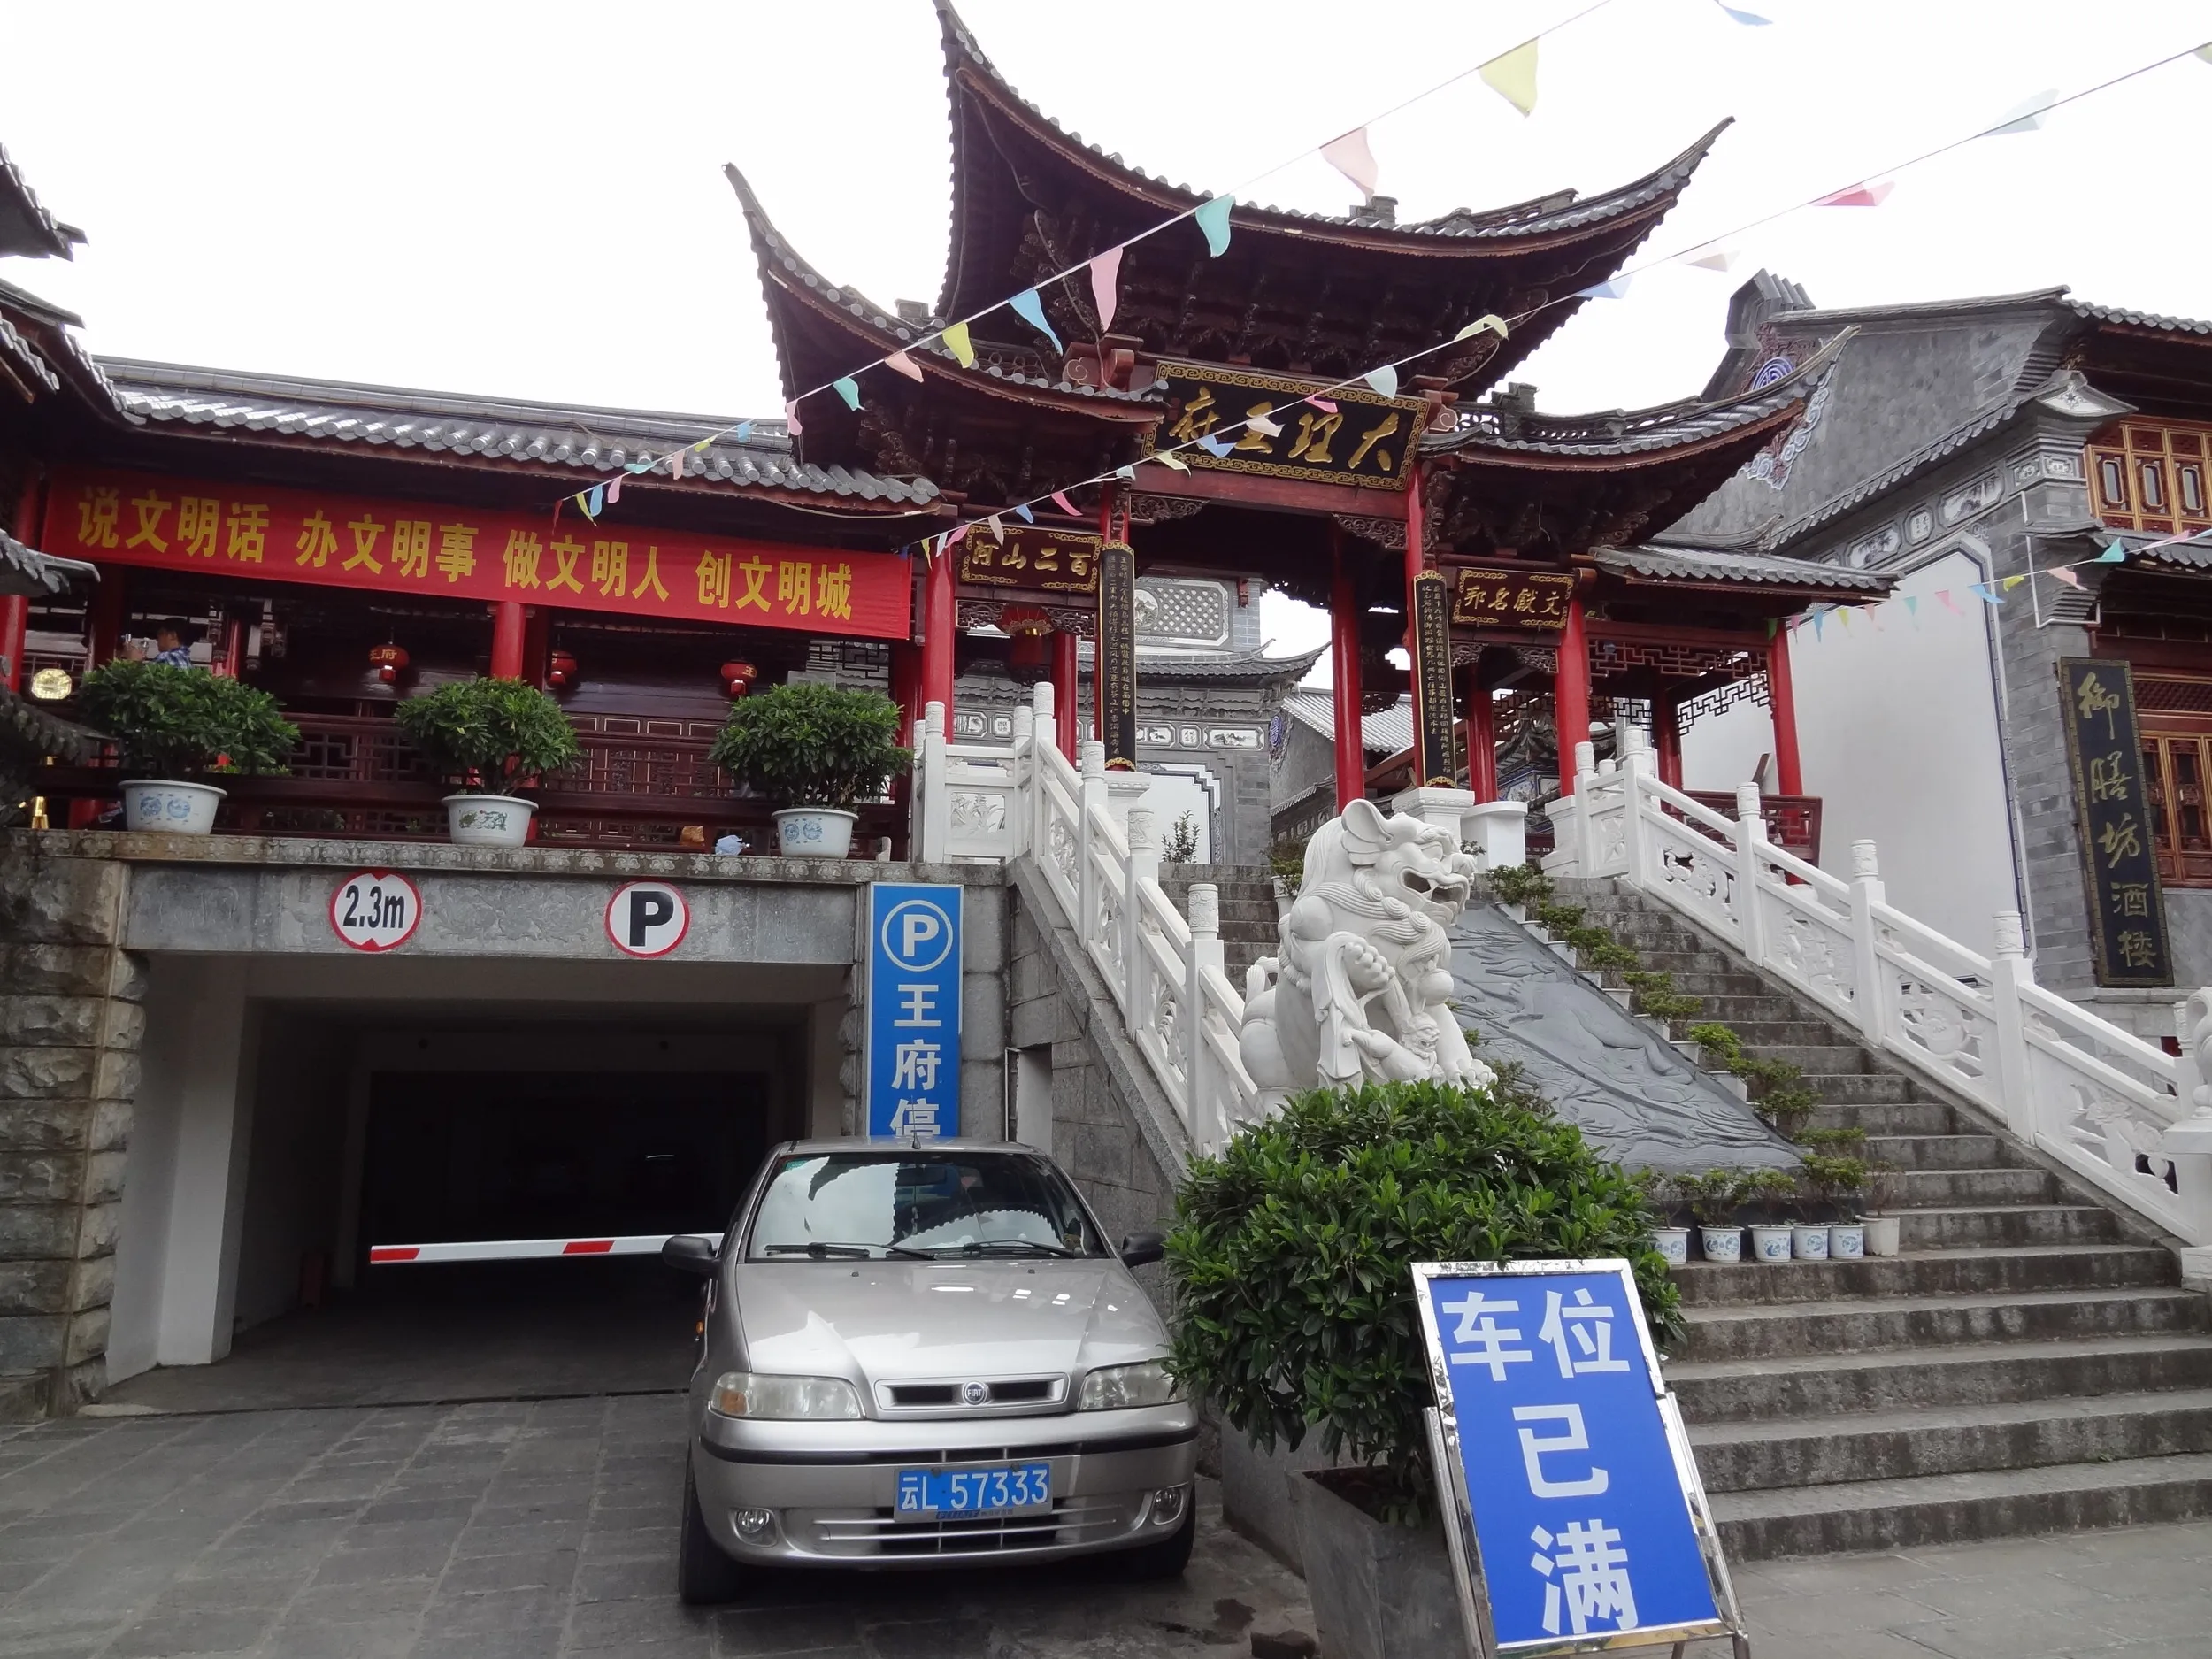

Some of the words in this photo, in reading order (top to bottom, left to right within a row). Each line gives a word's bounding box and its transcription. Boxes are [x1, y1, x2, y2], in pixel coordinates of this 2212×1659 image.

[78, 487, 270, 564] 说文明话
[296, 510, 479, 582] 办文明事
[503, 530, 669, 602] 做文明人
[695, 549, 852, 620] 创文明城
[342, 885, 405, 929] 2.3m
[628, 890, 674, 947] P
[902, 913, 939, 956] P
[889, 984, 941, 1136] 王府停
[1442, 1287, 1631, 1382] 车位
[967, 1388, 982, 1397] FIAT
